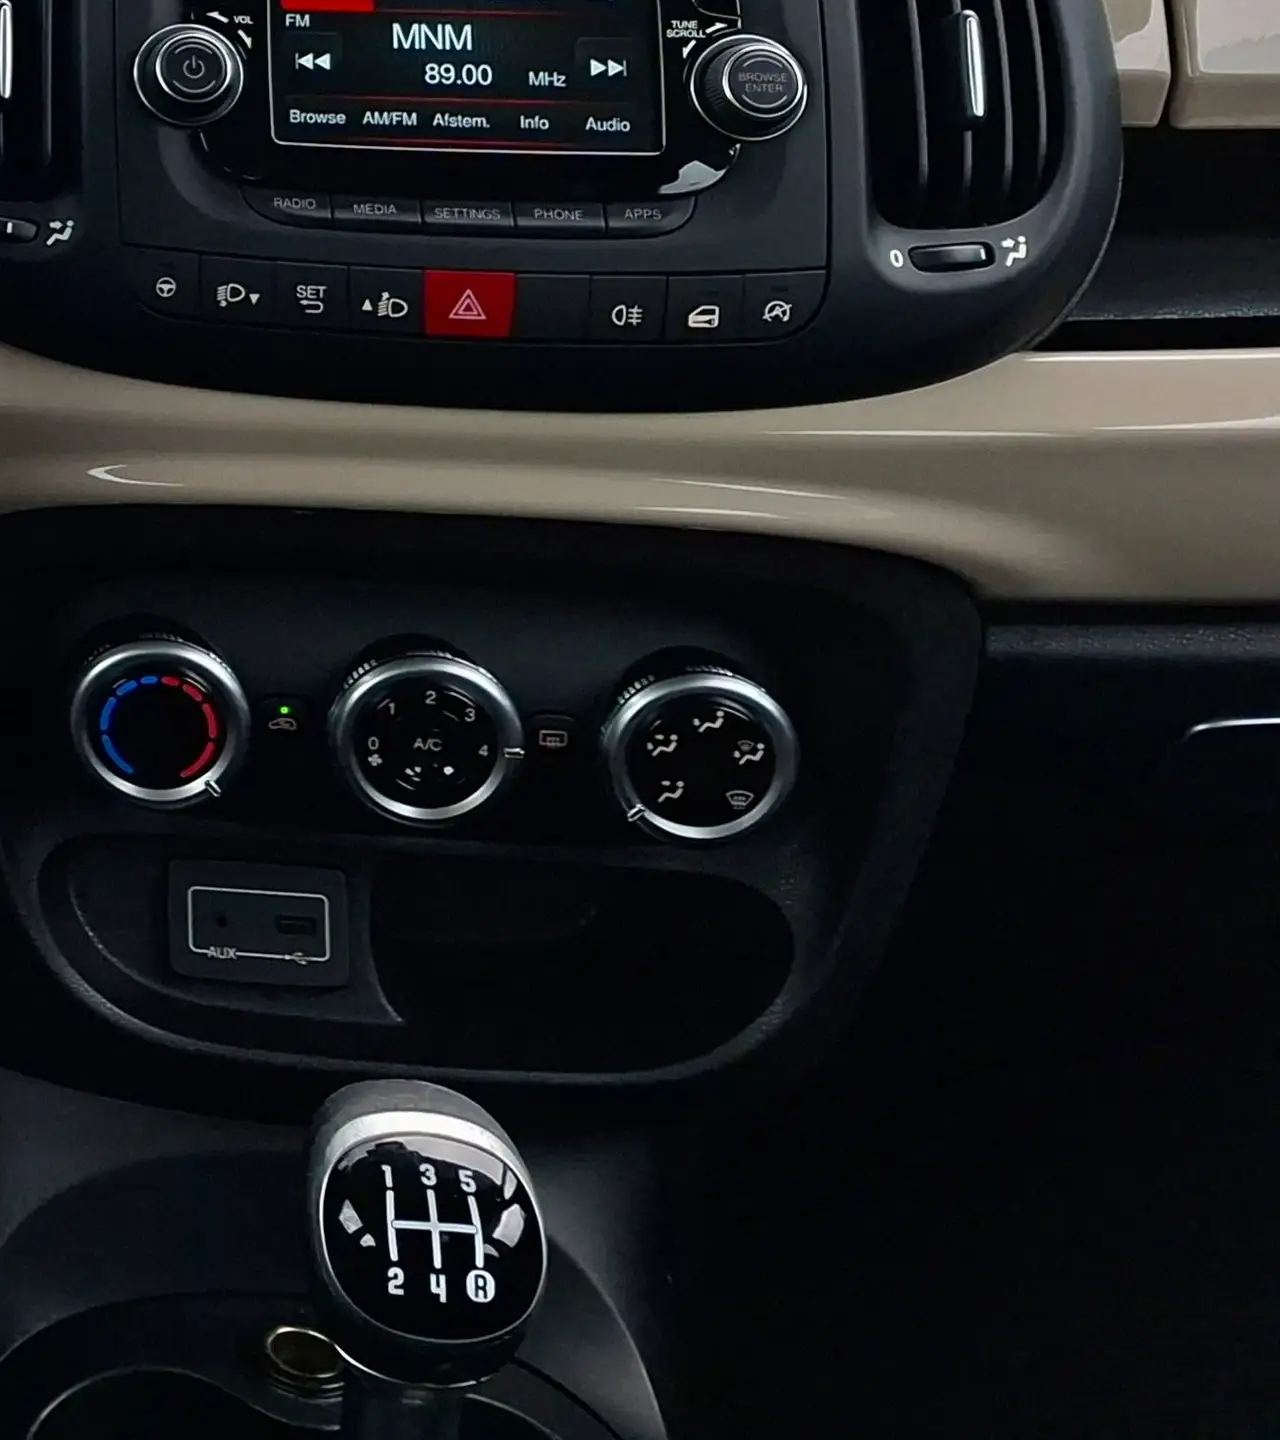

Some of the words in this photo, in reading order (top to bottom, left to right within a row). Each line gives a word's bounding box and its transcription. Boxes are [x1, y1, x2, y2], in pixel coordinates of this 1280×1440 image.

[234, 15, 254, 25] VOL
[286, 14, 310, 28] FM
[671, 20, 698, 29] TUNE
[392, 22, 474, 51] MNM
[666, 28, 706, 38] SCROLL
[424, 63, 493, 86] 89.00
[528, 72, 567, 87] MHz
[738, 71, 788, 83] BROWSE
[745, 83, 784, 93] ENTER
[289, 110, 346, 125] Browse
[362, 111, 418, 126] AM/FM
[432, 114, 490, 129] Afstem.
[520, 116, 549, 130] Info
[586, 117, 631, 132] Audio
[273, 196, 317, 210] RADIO
[353, 203, 397, 215] MEDIA
[434, 207, 501, 221] SETTINGS
[534, 208, 584, 221] PHONE
[624, 208, 662, 221] APPS
[889, 249, 904, 269] 0
[296, 284, 327, 299] SET
[425, 691, 437, 706] 2
[387, 701, 396, 716] 1
[464, 708, 476, 723] 3
[367, 736, 379, 750] 0
[413, 737, 443, 752] A/C
[478, 744, 489, 757] 4
[207, 946, 237, 960] AUX
[381, 1164, 394, 1188] 1
[419, 1163, 437, 1186] 3
[458, 1170, 477, 1194] 5
[387, 1267, 405, 1296] 2
[429, 1273, 448, 1303] 4
[473, 1273, 489, 1301] R
